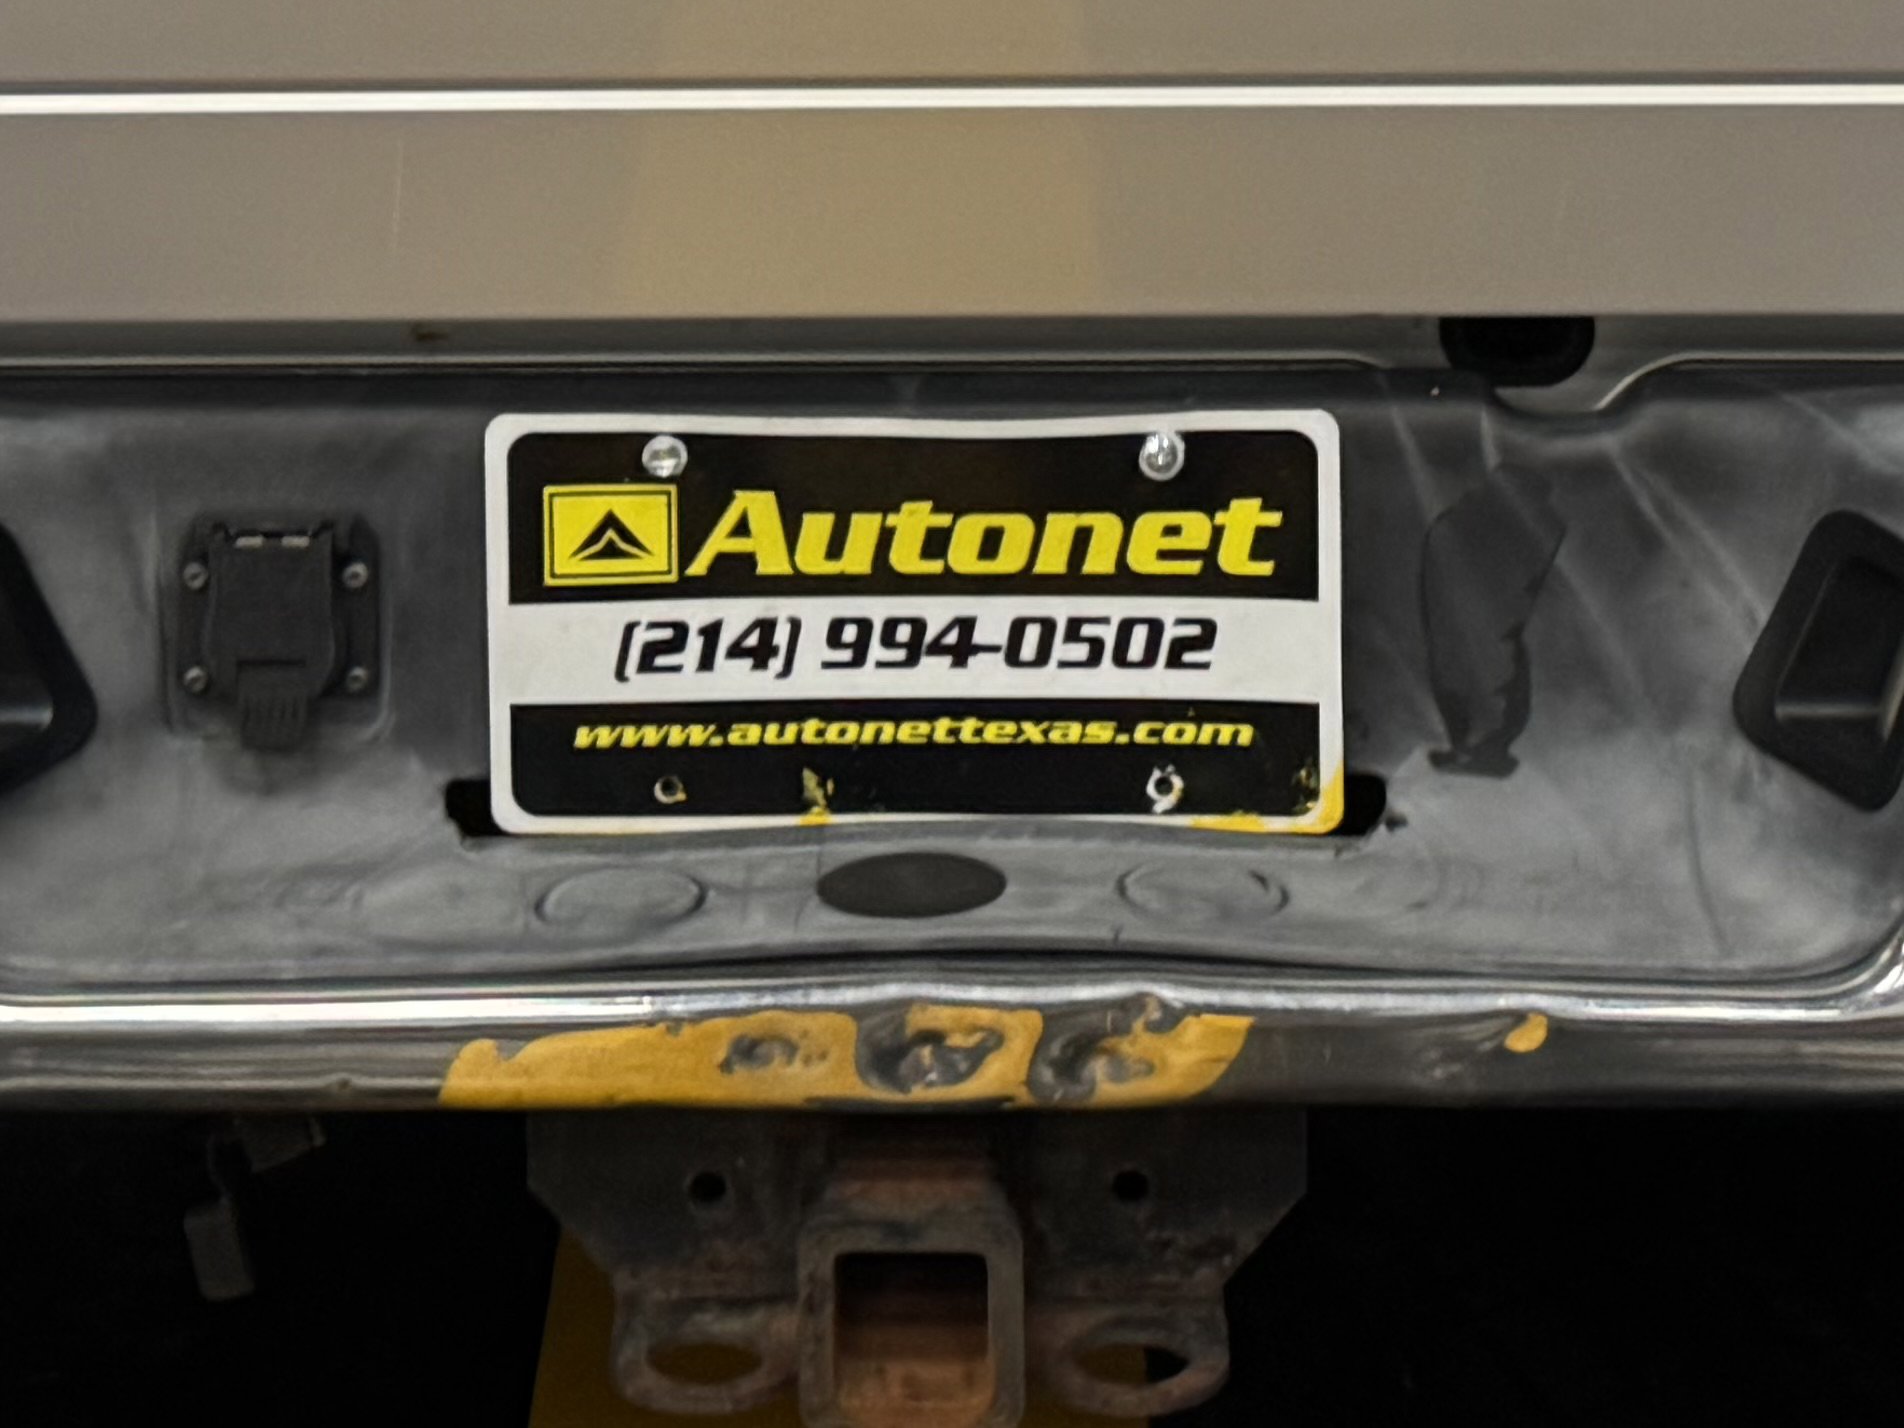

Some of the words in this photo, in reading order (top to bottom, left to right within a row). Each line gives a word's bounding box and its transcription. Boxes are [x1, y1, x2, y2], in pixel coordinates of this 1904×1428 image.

[684, 489, 1284, 577] Autonet
[614, 616, 802, 684] (214)
[819, 615, 1220, 672] 994-0502
[571, 716, 1256, 750] www.autonettexas.com
